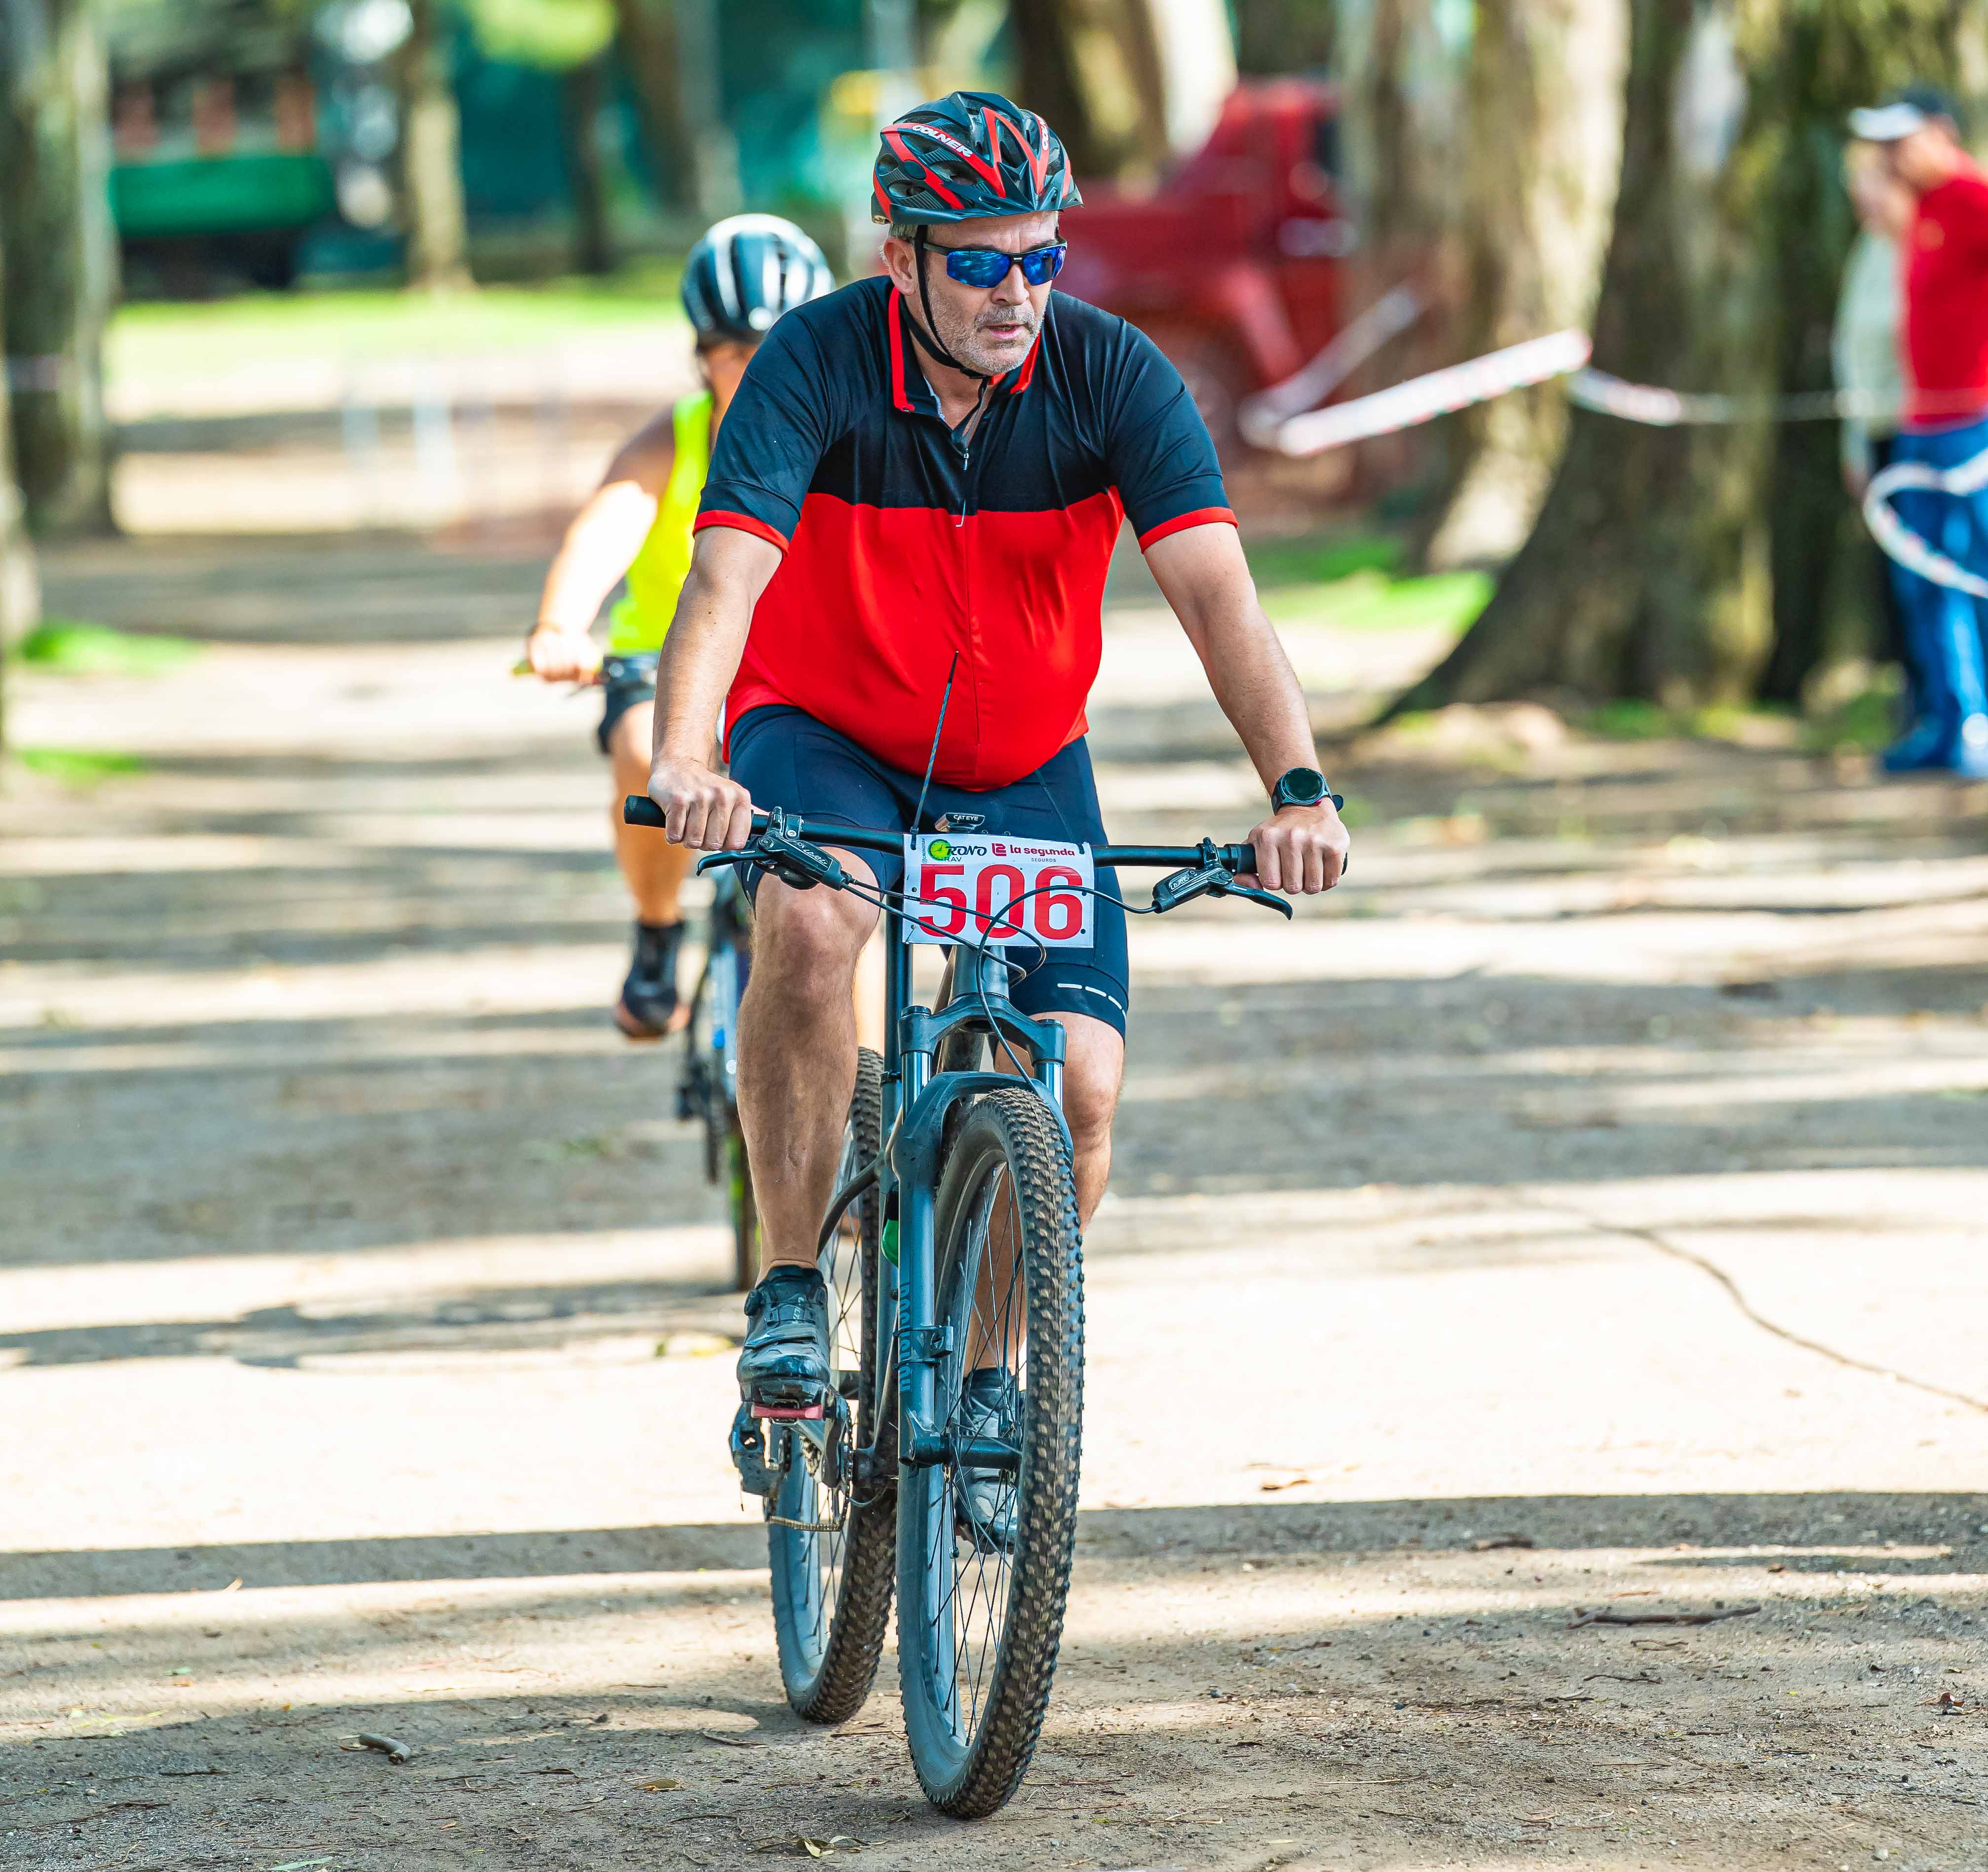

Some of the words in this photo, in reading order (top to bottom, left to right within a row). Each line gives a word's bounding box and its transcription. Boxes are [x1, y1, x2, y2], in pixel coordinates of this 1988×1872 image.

[912, 125, 972, 157] COLNER
[1010, 844, 1021, 854] la
[1024, 846, 1075, 857] segunda
[919, 864, 1083, 940] 506
